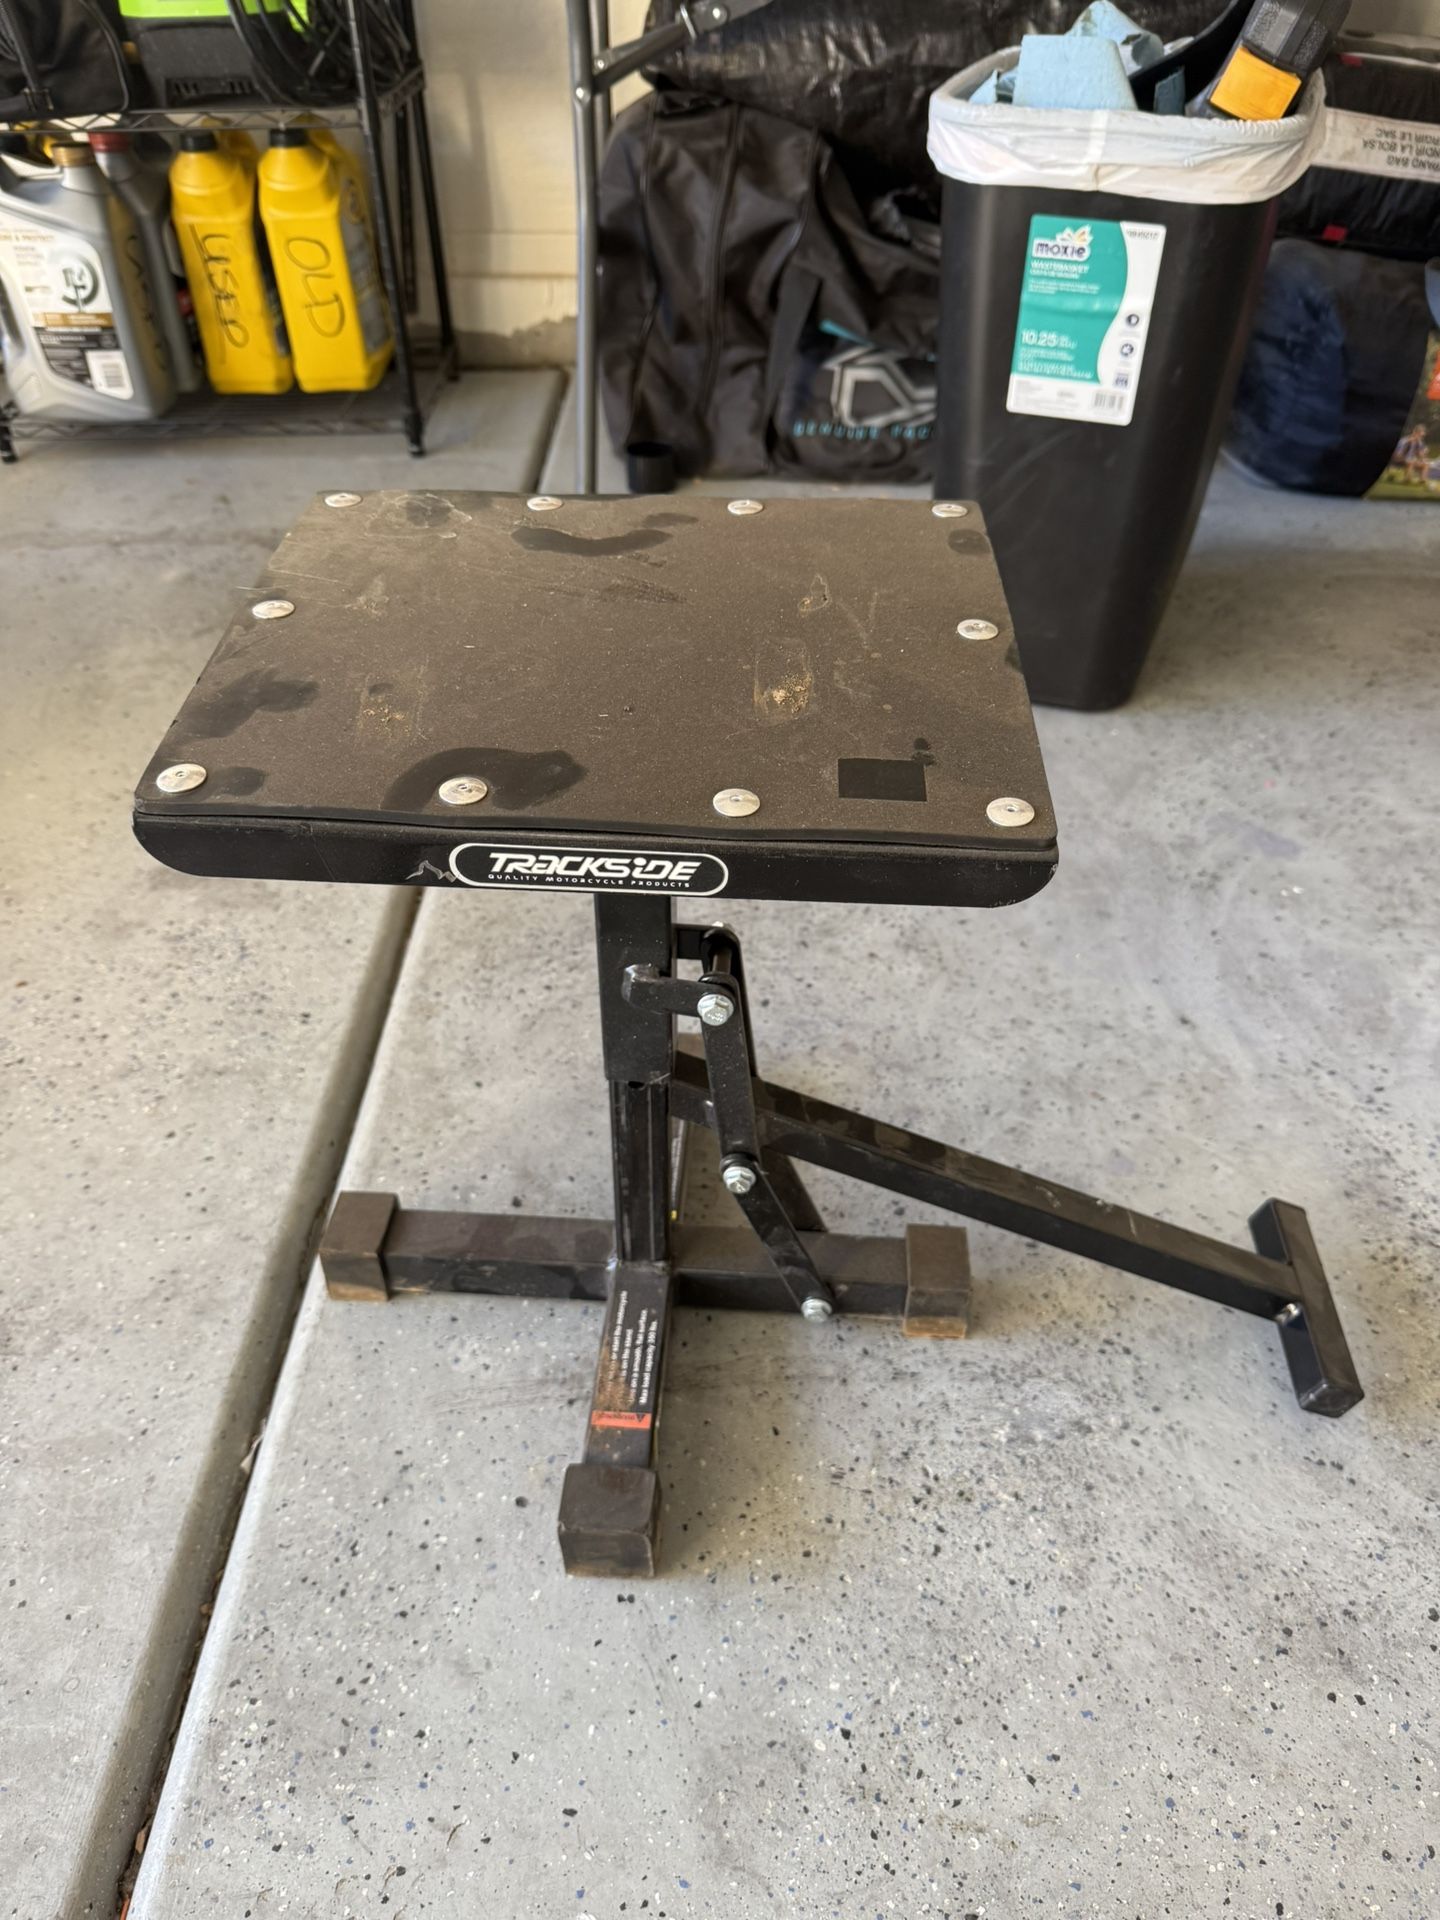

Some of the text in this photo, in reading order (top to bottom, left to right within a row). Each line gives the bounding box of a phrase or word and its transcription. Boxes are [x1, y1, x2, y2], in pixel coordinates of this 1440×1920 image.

[1376, 128, 1396, 139] SAC
[1362, 138, 1397, 152] BOLSA
[1401, 143, 1413, 155] LA
[1386, 155, 1409, 168] BAG
[1035, 242, 1086, 257] moxie
[201, 234, 249, 348] USED
[284, 236, 345, 338] OLD
[545, 876, 623, 885] MOTORCYCLE
[631, 880, 690, 888] PRODUCTS
